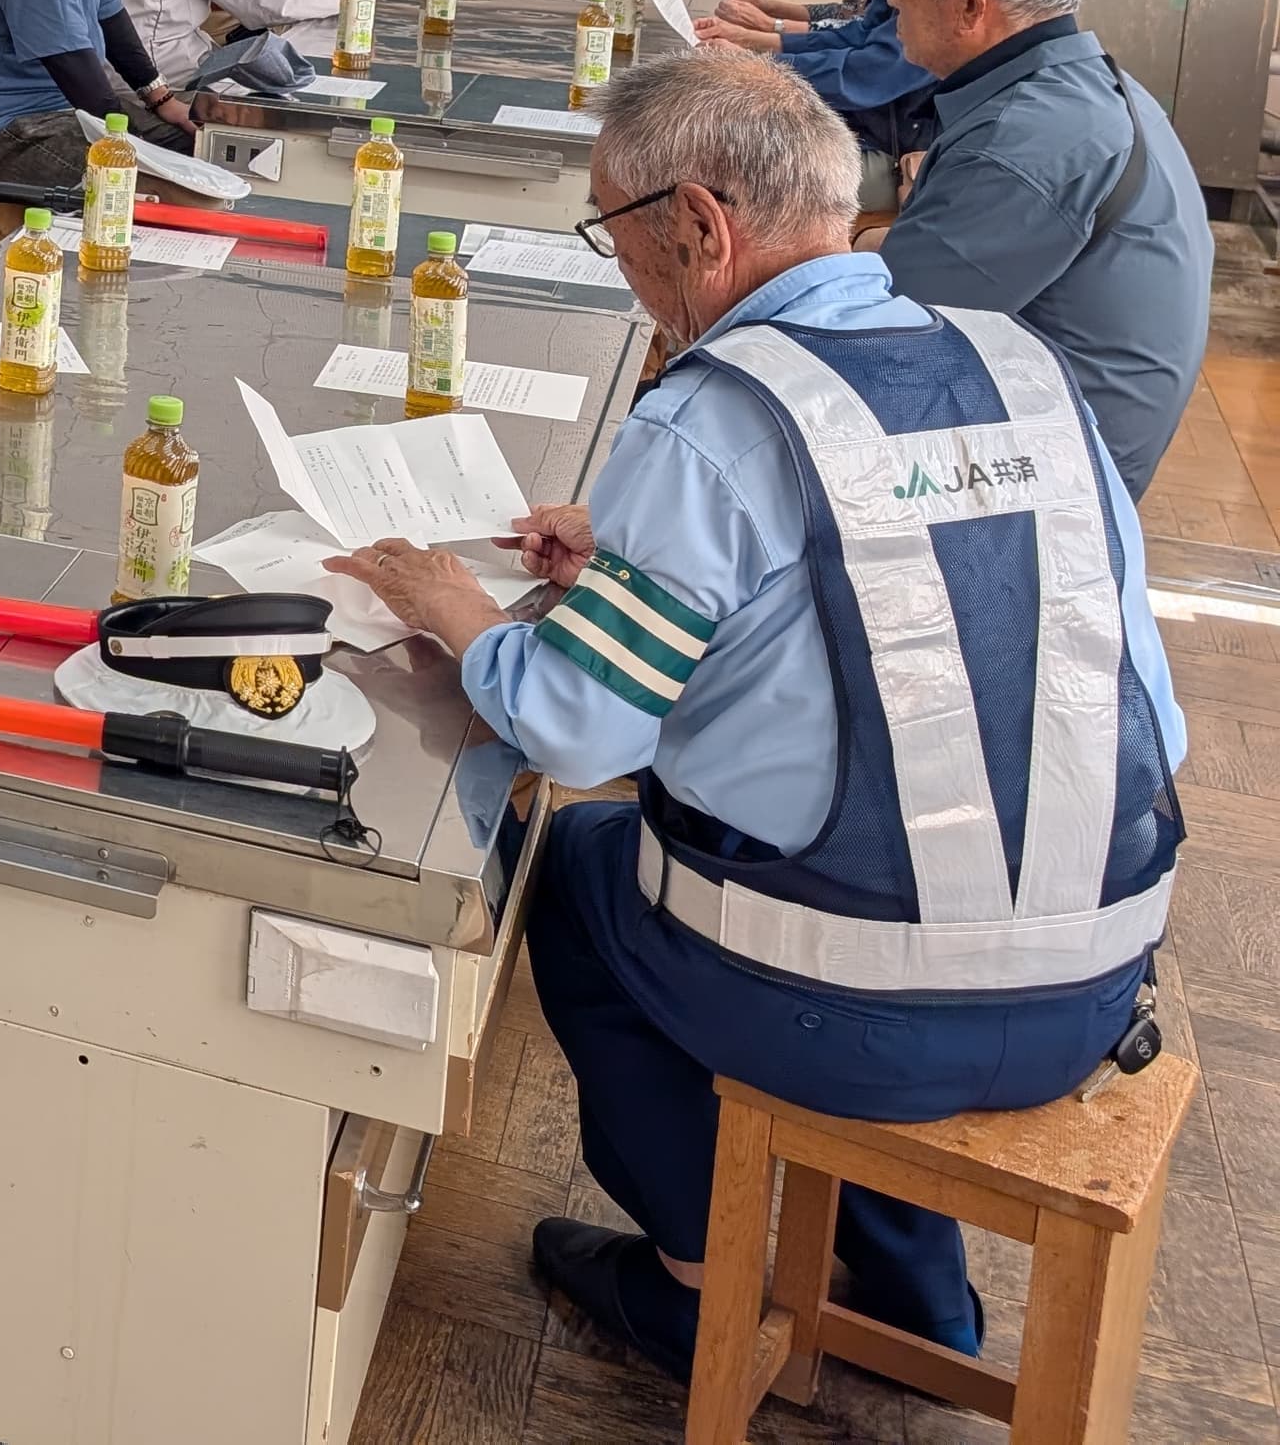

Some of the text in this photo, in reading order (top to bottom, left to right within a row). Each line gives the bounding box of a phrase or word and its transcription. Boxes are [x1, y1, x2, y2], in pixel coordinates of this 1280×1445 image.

[14, 311, 31, 361] 伊右衛門
[144, 497, 155, 519] 京都
[133, 527, 151, 583] 伊右衛門
